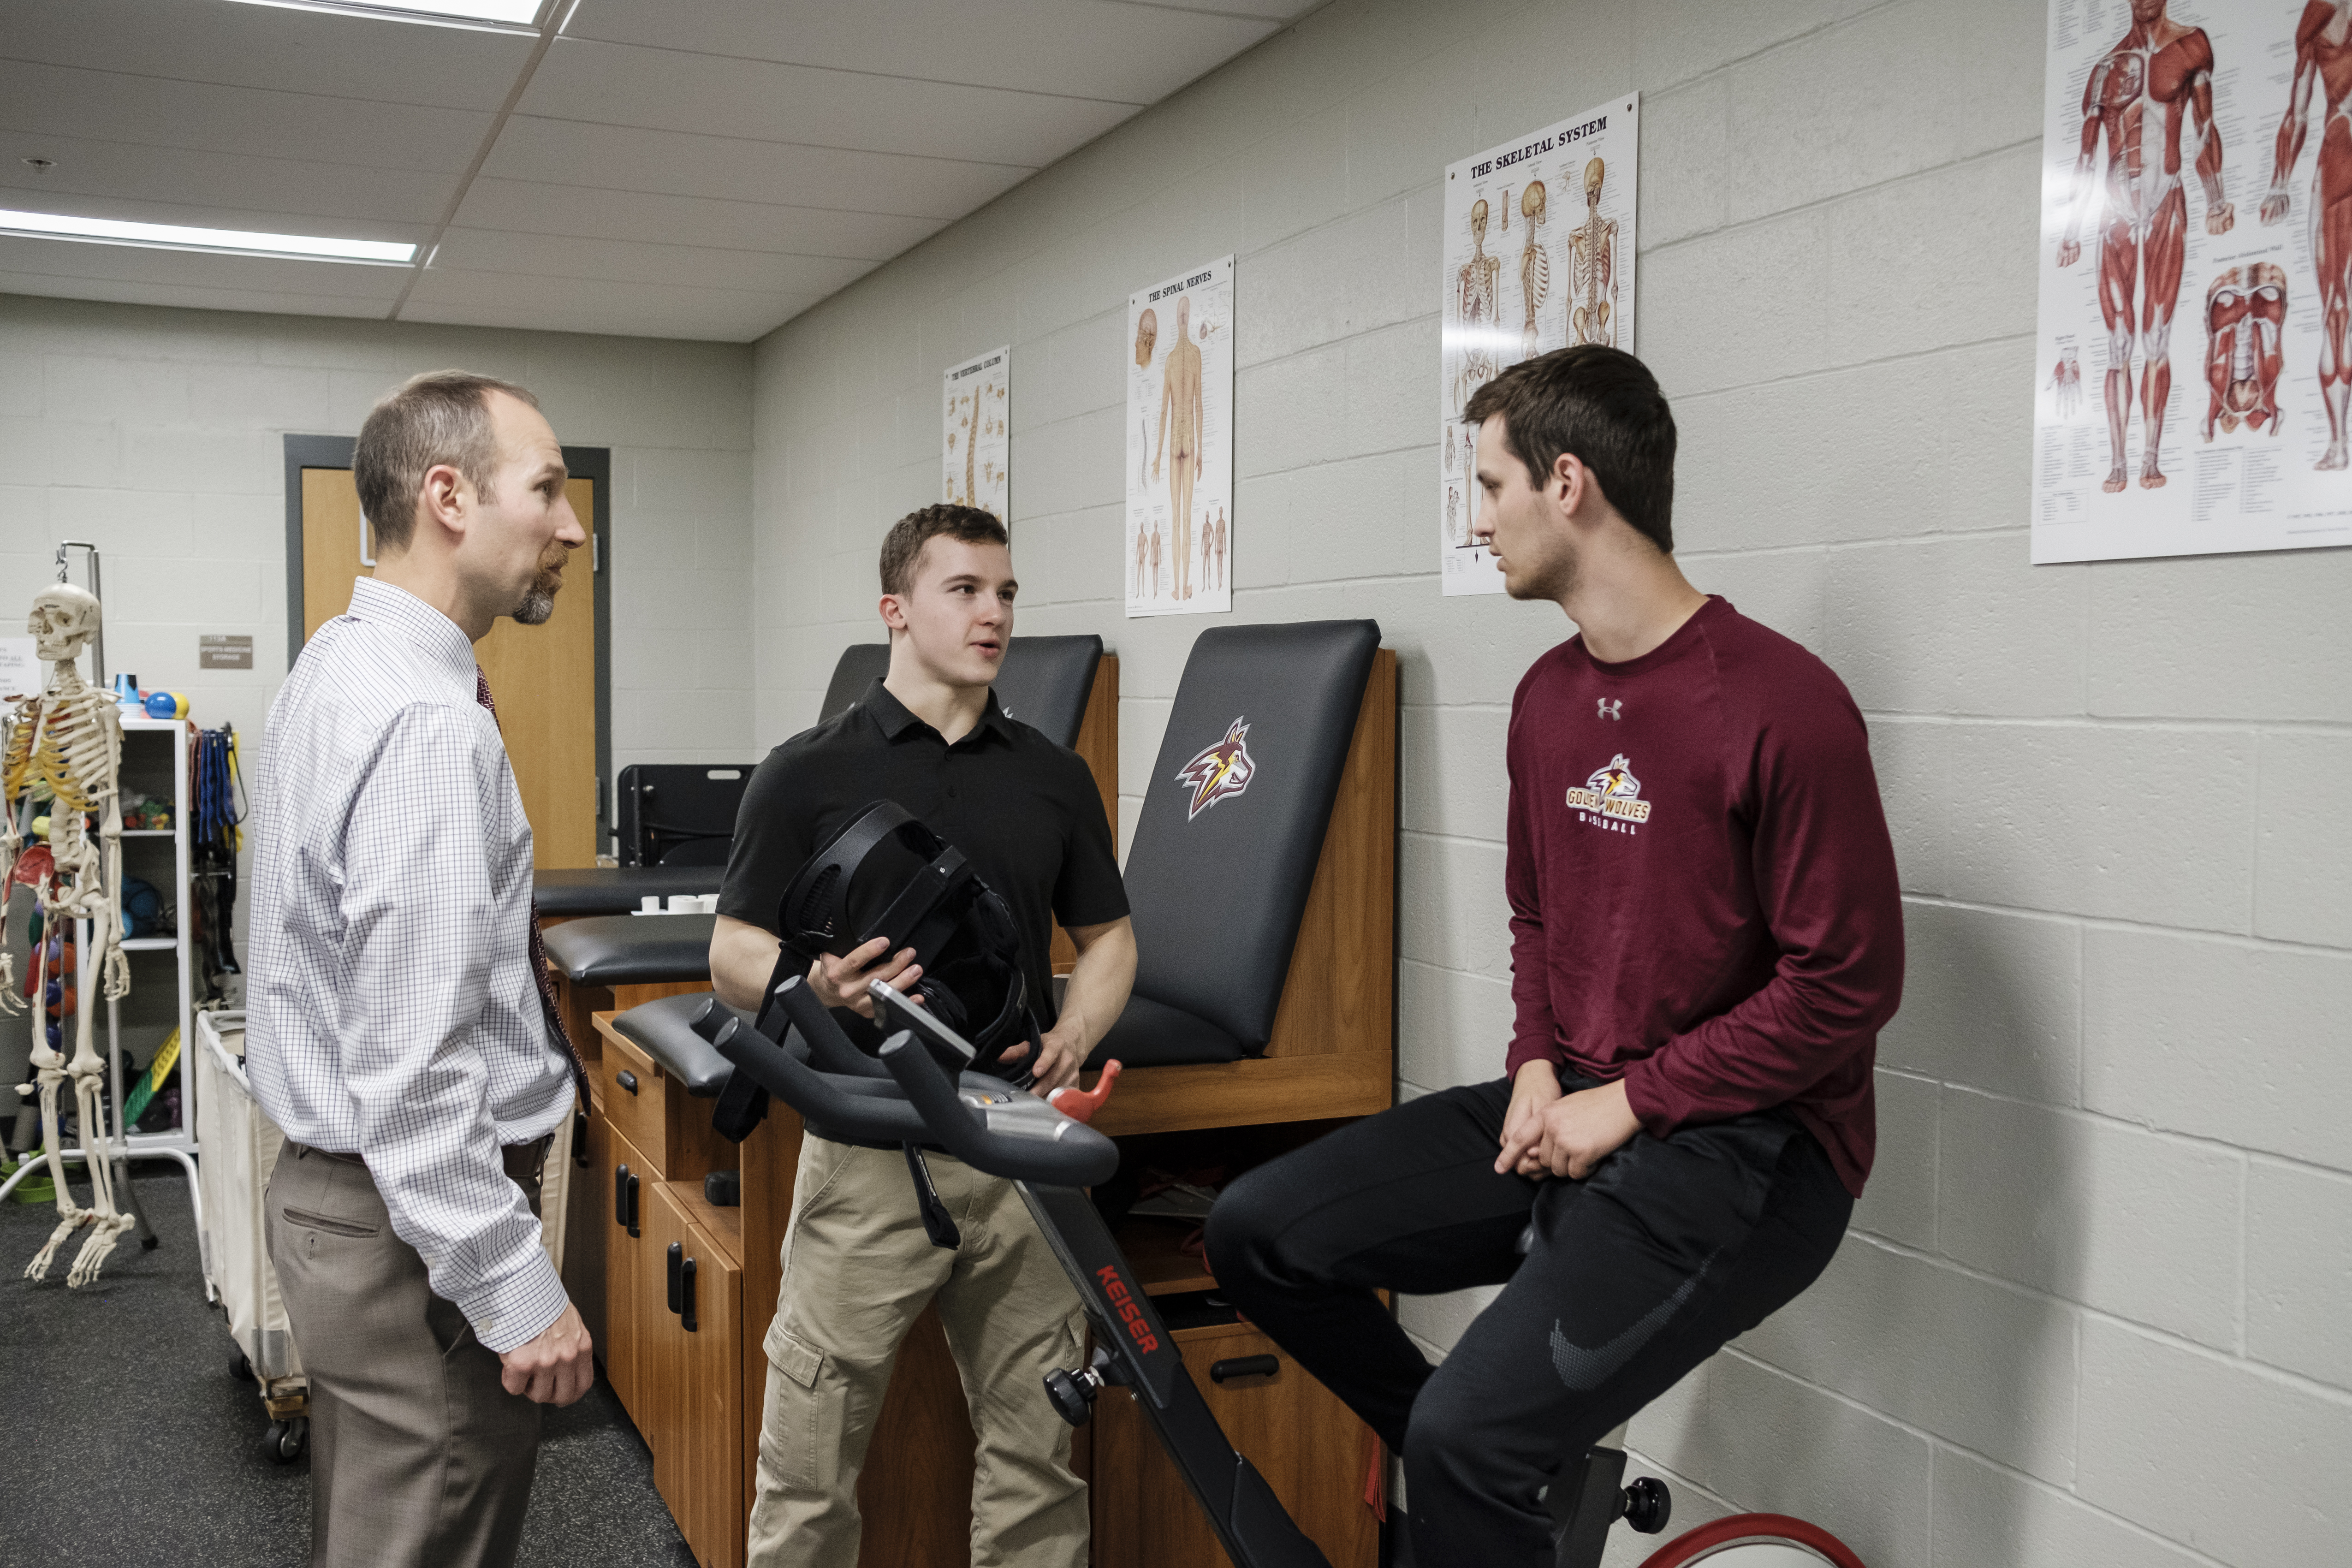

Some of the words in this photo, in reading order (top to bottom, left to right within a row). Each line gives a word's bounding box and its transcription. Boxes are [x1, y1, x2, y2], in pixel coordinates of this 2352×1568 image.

[1471, 161, 1492, 179] THE
[1496, 137, 1554, 170] SKELETAL
[1558, 116, 1607, 147] SYSTEM
[1149, 290, 1160, 303] THE
[1163, 281, 1184, 297] SPINAL
[1187, 270, 1212, 288] NERVES
[1568, 790, 1599, 808] GOLEN
[1605, 798, 1648, 819] WOLVES
[1096, 1265, 1158, 1354] KEISER
